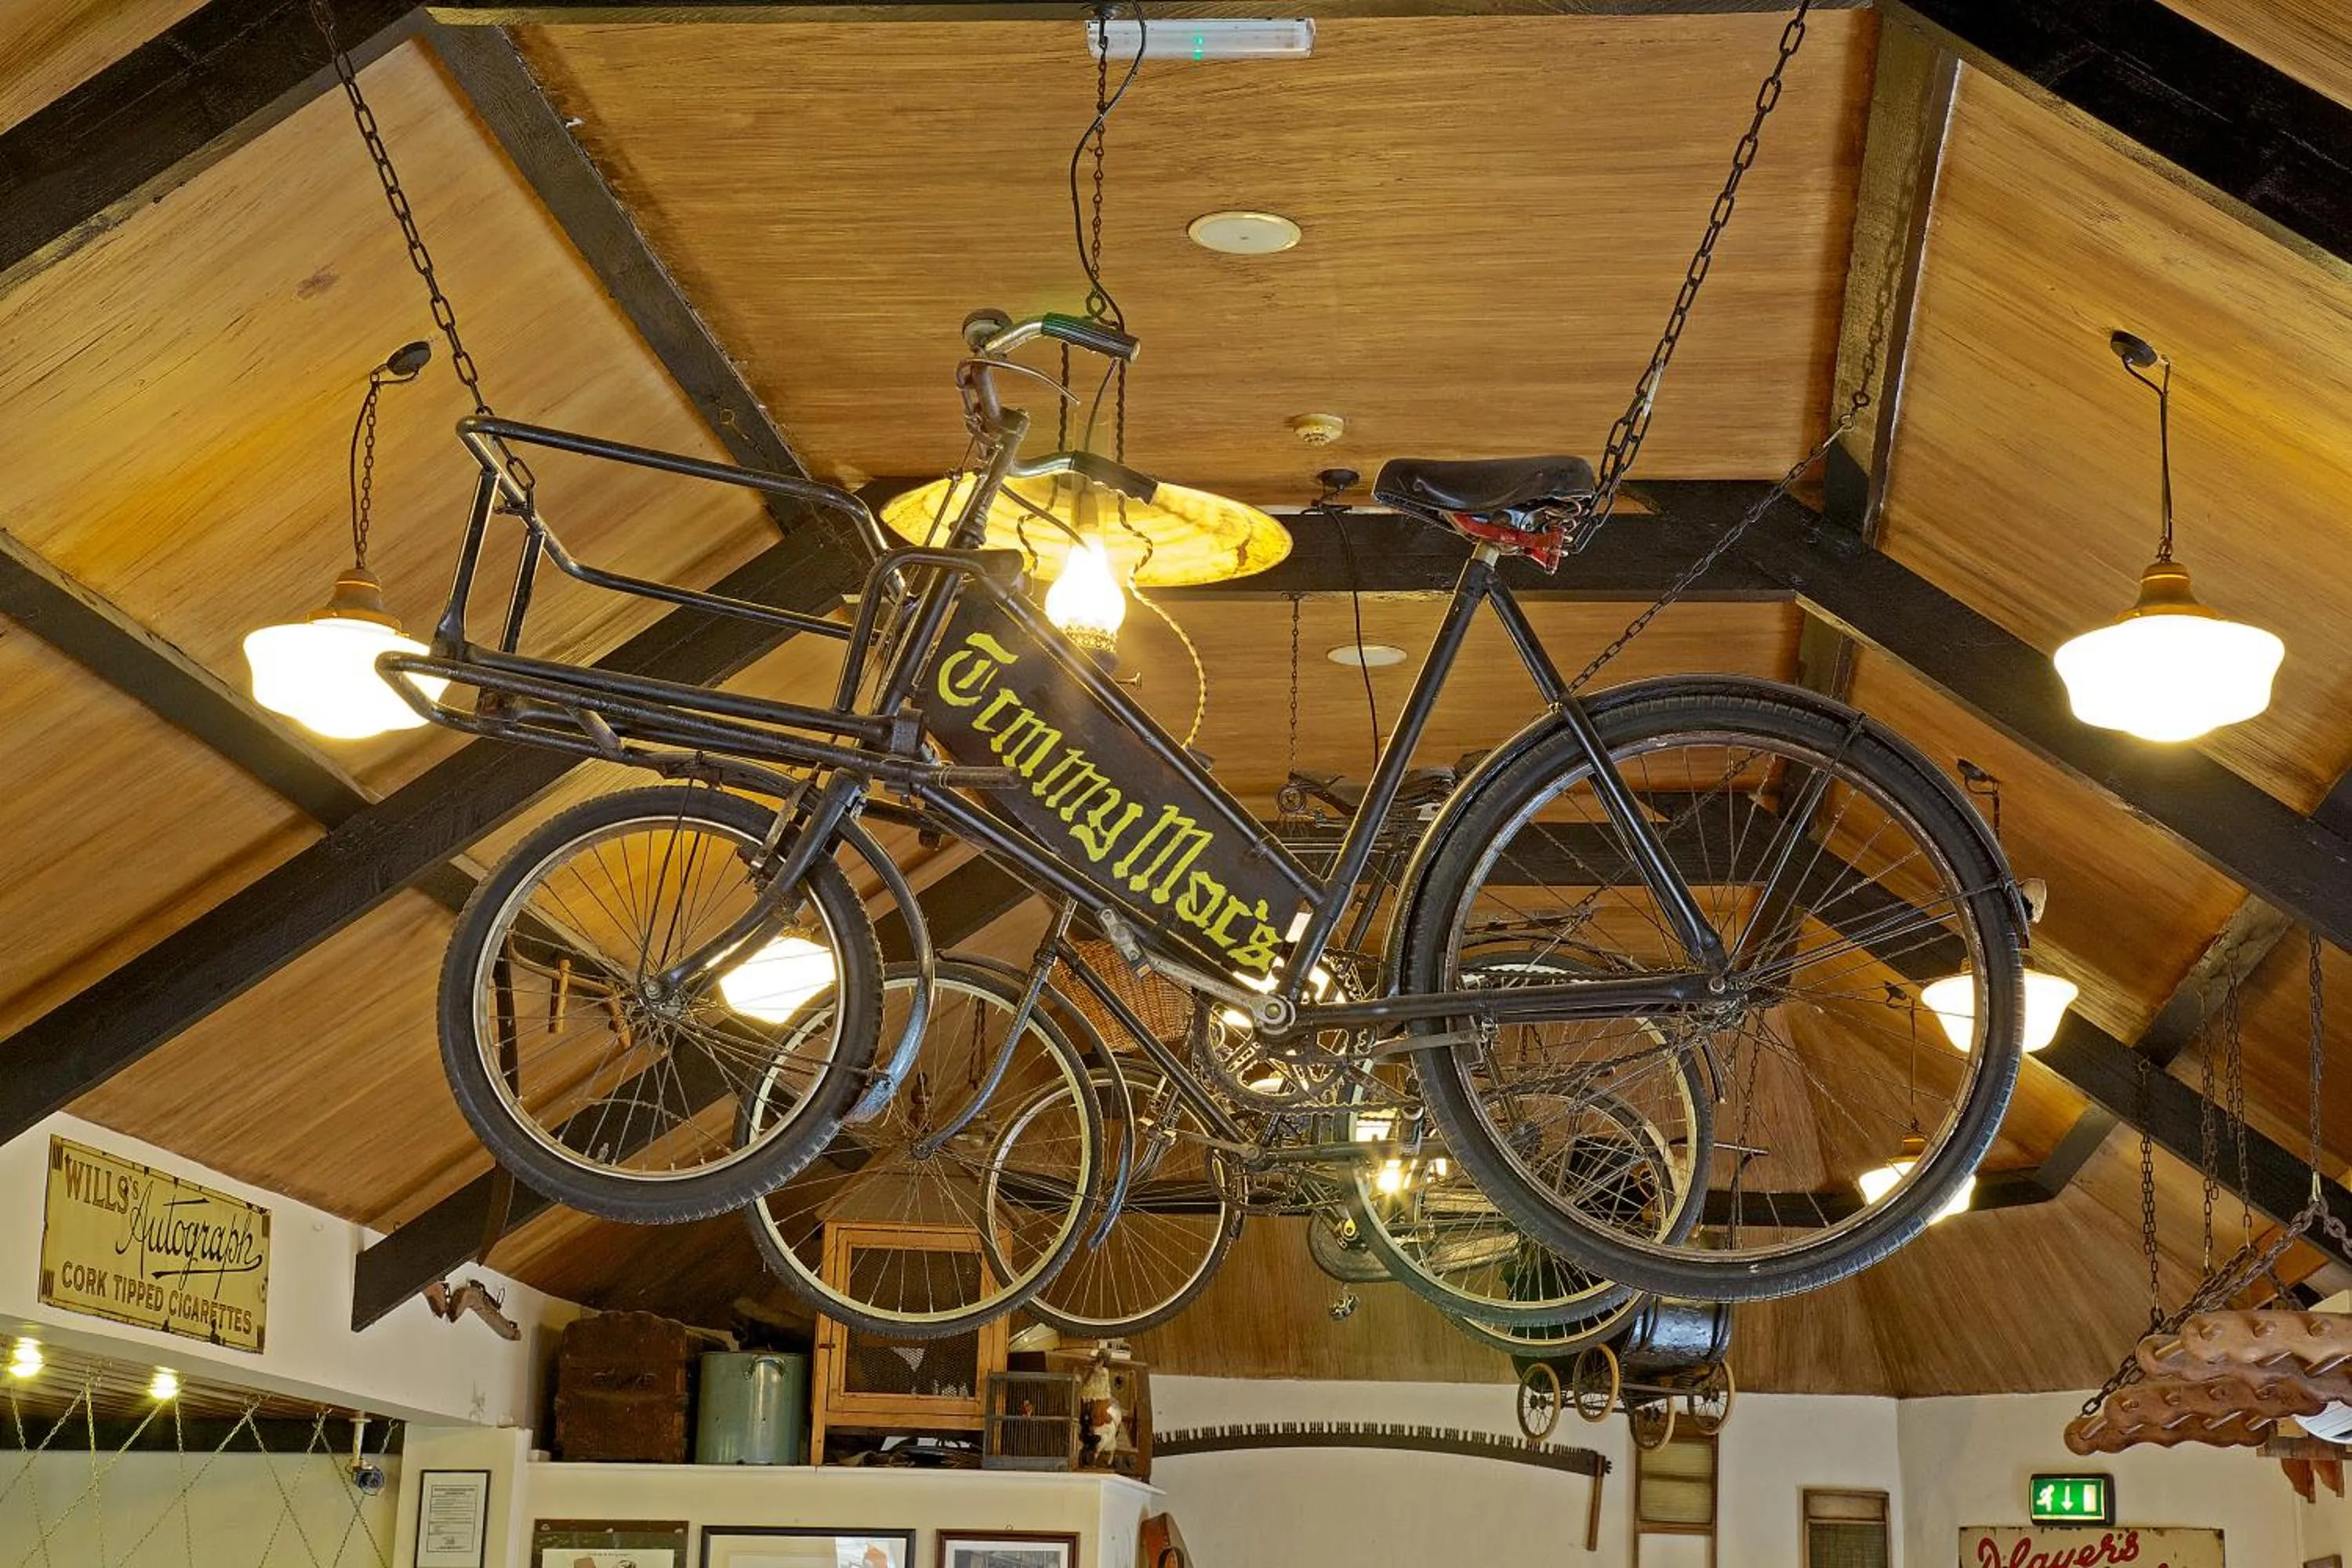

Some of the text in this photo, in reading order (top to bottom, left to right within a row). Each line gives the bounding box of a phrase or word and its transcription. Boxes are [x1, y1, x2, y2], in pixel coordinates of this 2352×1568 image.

[116, 1178, 263, 1299] Autograph
[61, 1260, 253, 1335] CORK TIPPED CIGARETTES
